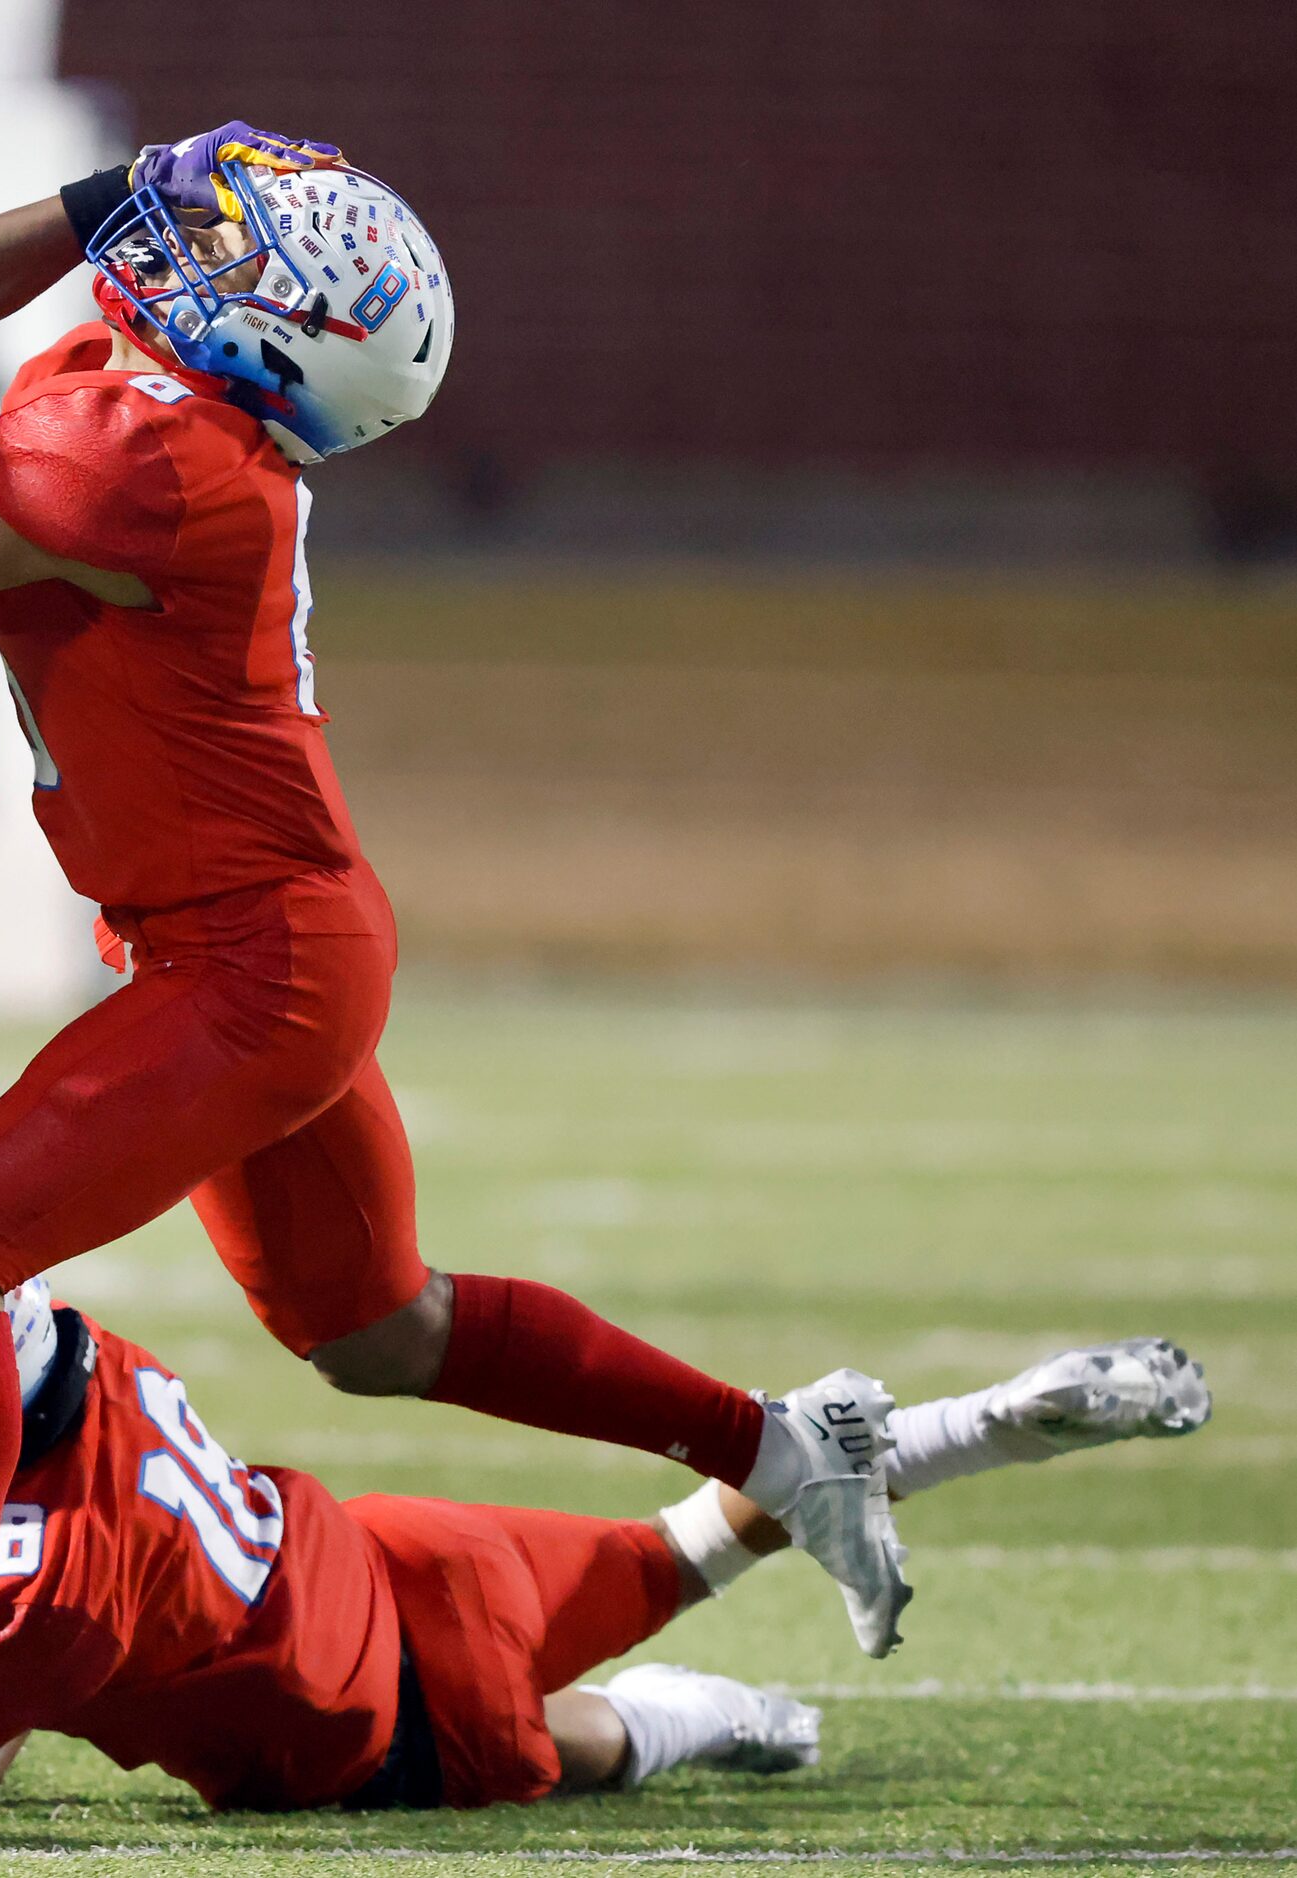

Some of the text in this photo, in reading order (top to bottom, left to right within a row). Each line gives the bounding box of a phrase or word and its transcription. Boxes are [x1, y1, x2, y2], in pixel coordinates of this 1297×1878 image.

[261, 192, 282, 211] FIGHT
[304, 185, 320, 205] FIGHT
[345, 204, 359, 228] FIGHT
[341, 232, 357, 251] 22
[367, 225, 378, 244] 22
[298, 235, 323, 258] FIGHT
[322, 265, 340, 284] HUNT
[352, 256, 370, 276] 22
[349, 259, 411, 334] 8
[242, 312, 269, 333] FIGHT
[272, 324, 294, 344] GUTS
[133, 1366, 284, 1608] 18
